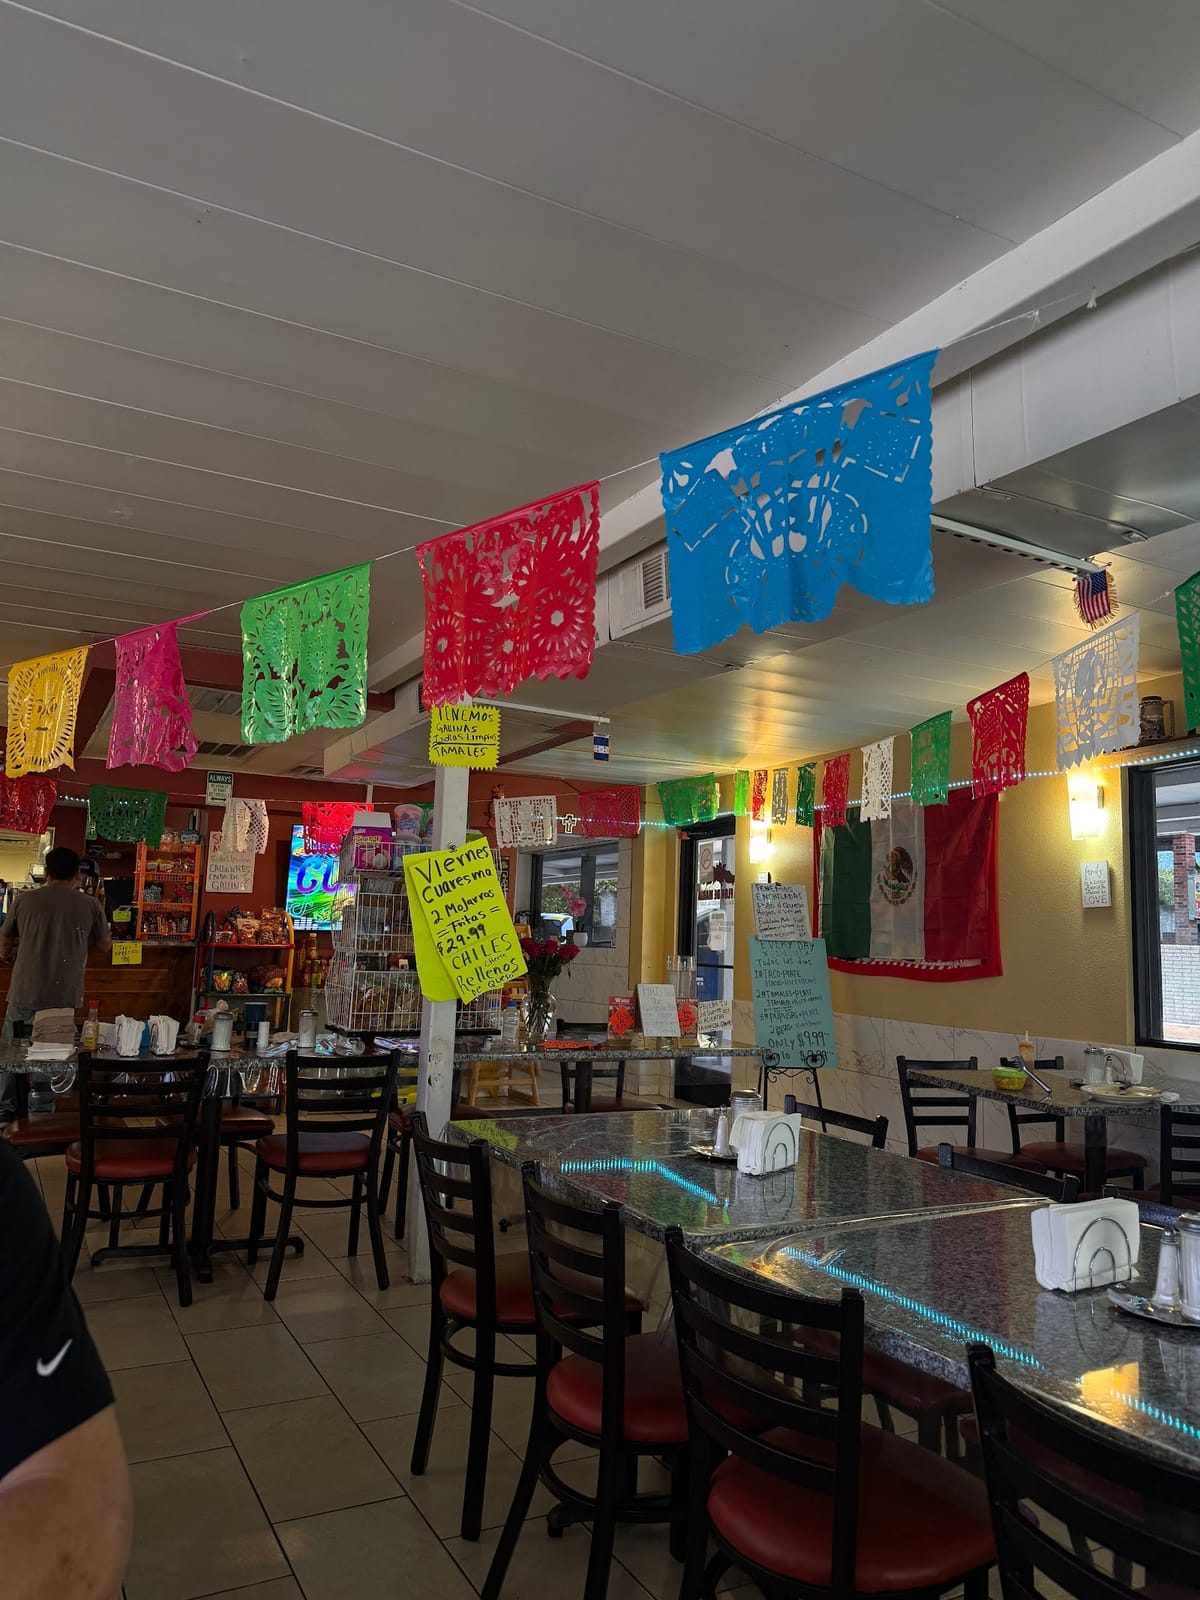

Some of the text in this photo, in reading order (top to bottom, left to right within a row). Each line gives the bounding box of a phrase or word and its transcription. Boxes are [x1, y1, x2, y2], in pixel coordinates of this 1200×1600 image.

[433, 746, 488, 758] TAMALES
[209, 773, 232, 783] ALWAYS
[421, 868, 493, 904] Cuaresma
[431, 909, 443, 925] 2
[436, 923, 487, 957] $29.99
[452, 933, 513, 970] CHILES
[456, 957, 519, 995] Rellenos
[768, 1038, 797, 1050] ONLY
